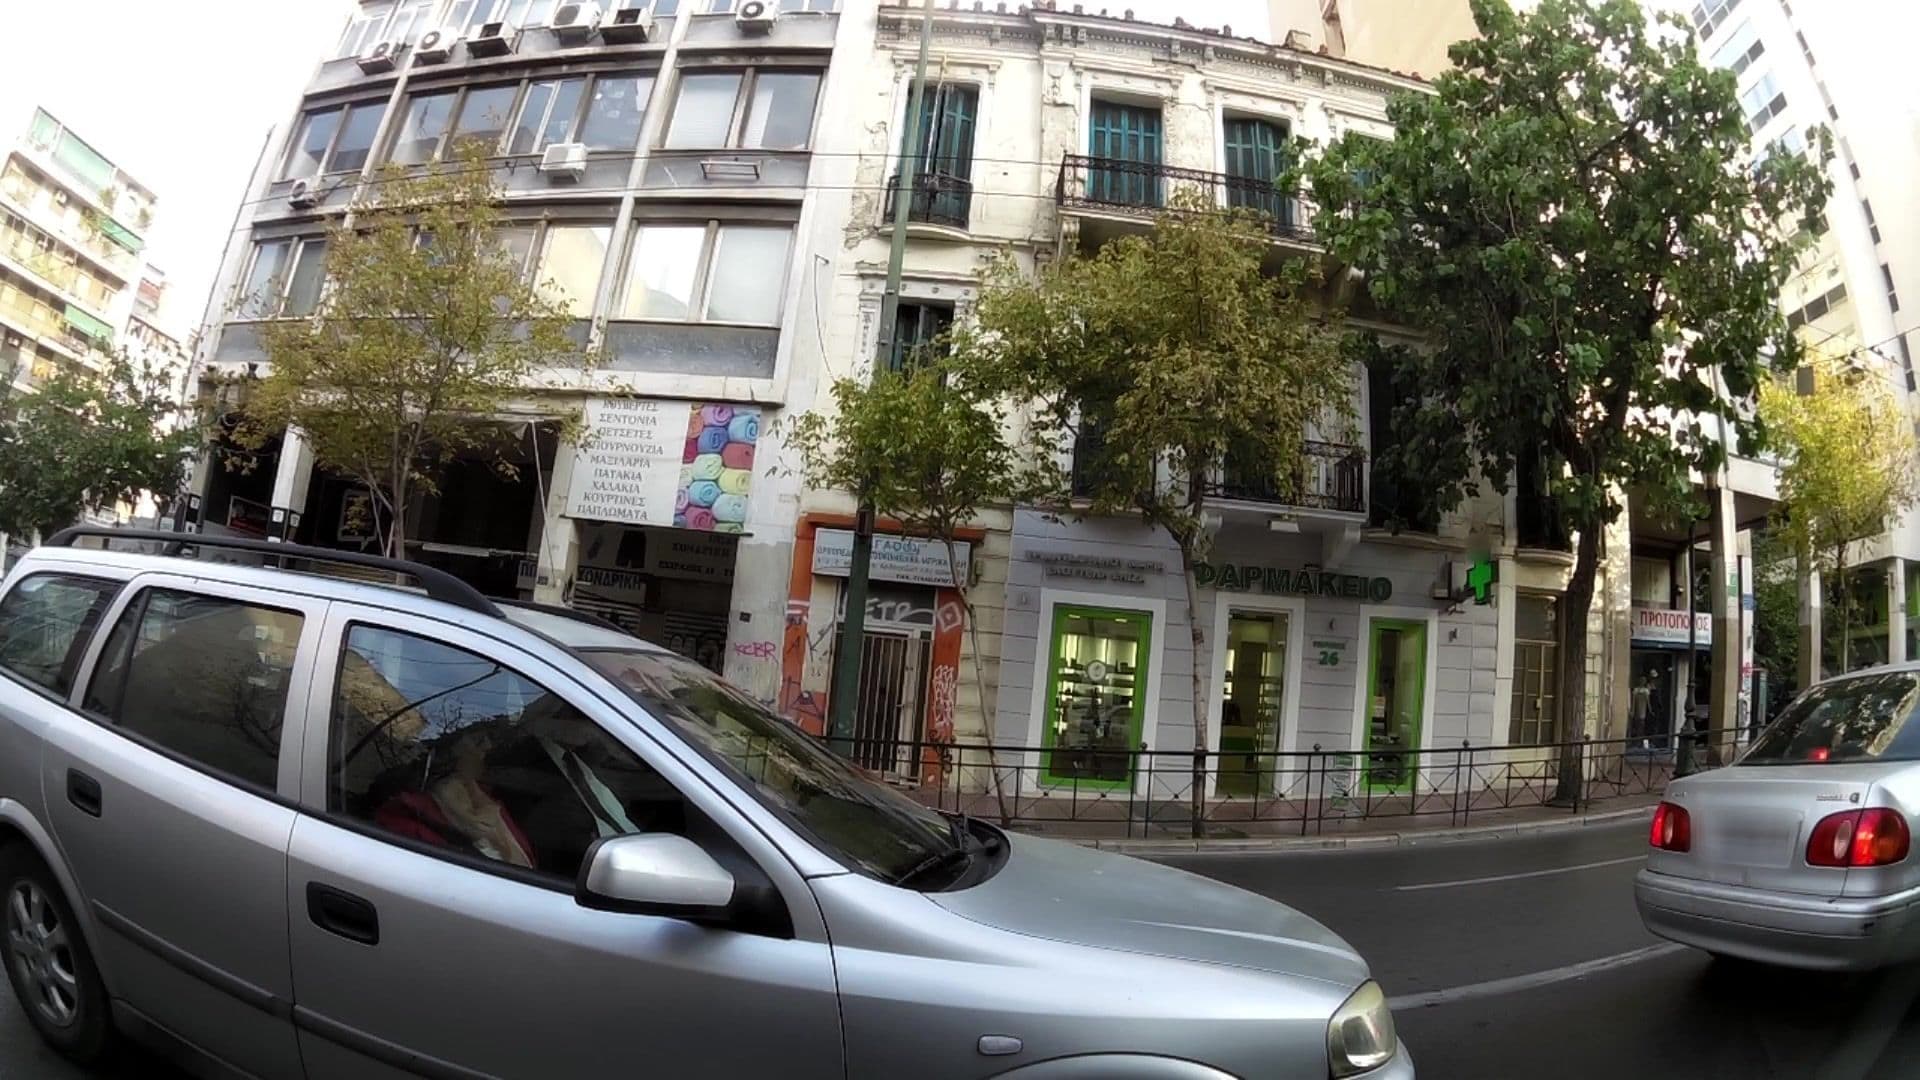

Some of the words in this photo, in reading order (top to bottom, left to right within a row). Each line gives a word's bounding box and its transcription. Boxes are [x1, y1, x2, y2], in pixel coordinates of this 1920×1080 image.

[600, 413, 657, 426] ΣΕΝΤΟΝΙΑ
[583, 440, 664, 455] ΠΟΥΡΝΟΥΖΙΑ
[590, 455, 651, 469] ΜΑΞΙΛΑΡΙΑ
[594, 468, 643, 481] ΠΑΤΑΚΙΑ
[593, 481, 640, 494] ΧΑΛΑΚΙΑ
[583, 492, 646, 507] ΚΟΥΡΤΙΝΕΣ
[577, 504, 649, 521] ΠΑΠΛΩΜΑΤΑ
[1640, 610, 1710, 632] ΠΡΟΤΟΠΟΟΣ
[1319, 651, 1339, 666] 26
